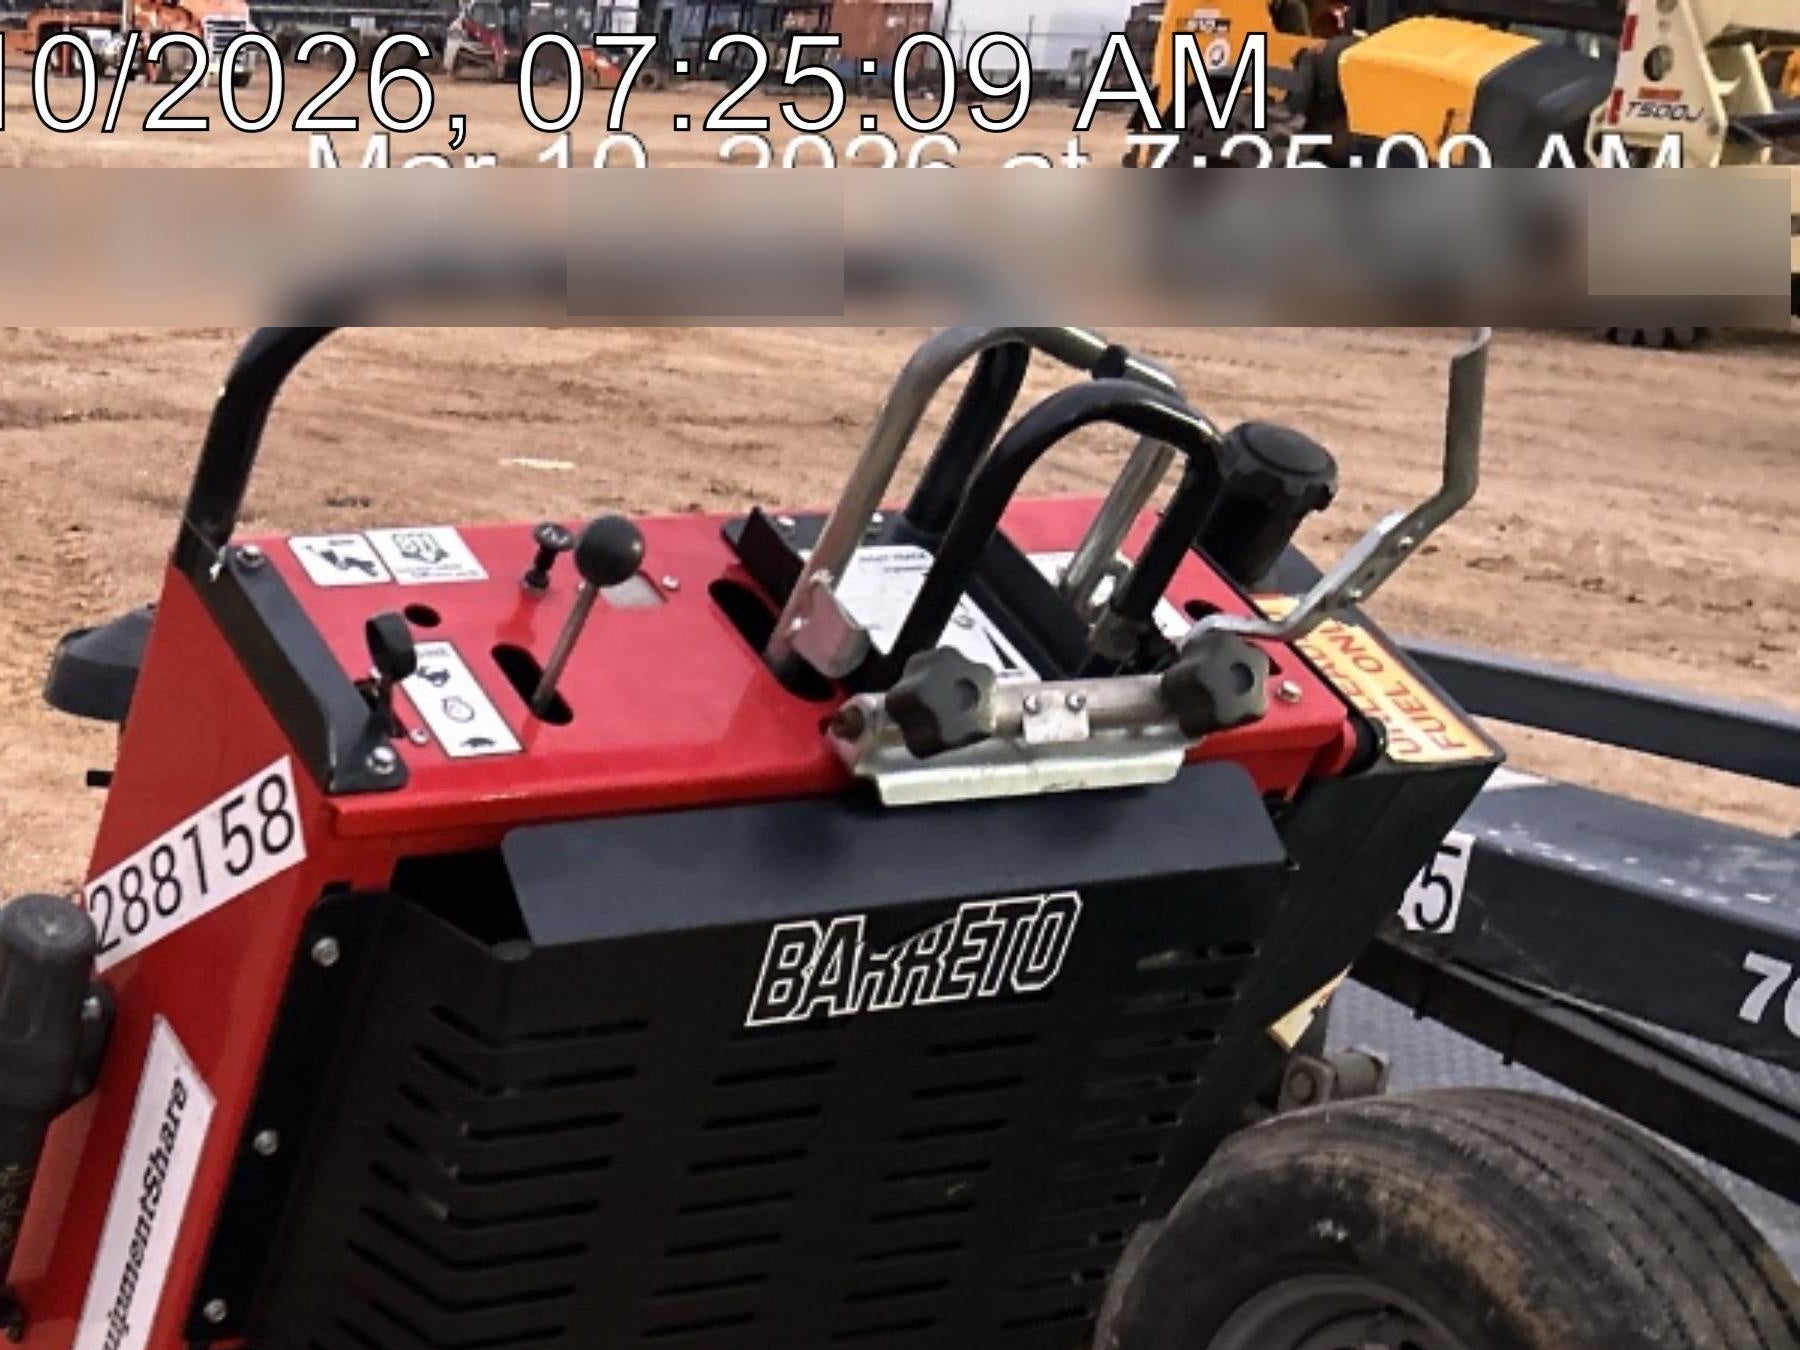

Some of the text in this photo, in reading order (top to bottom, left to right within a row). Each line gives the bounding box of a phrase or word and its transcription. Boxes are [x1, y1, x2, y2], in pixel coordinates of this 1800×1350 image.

[1385, 680, 1468, 751] FUEL
[88, 773, 295, 956] 288158
[743, 890, 1082, 1027] BARRETO
